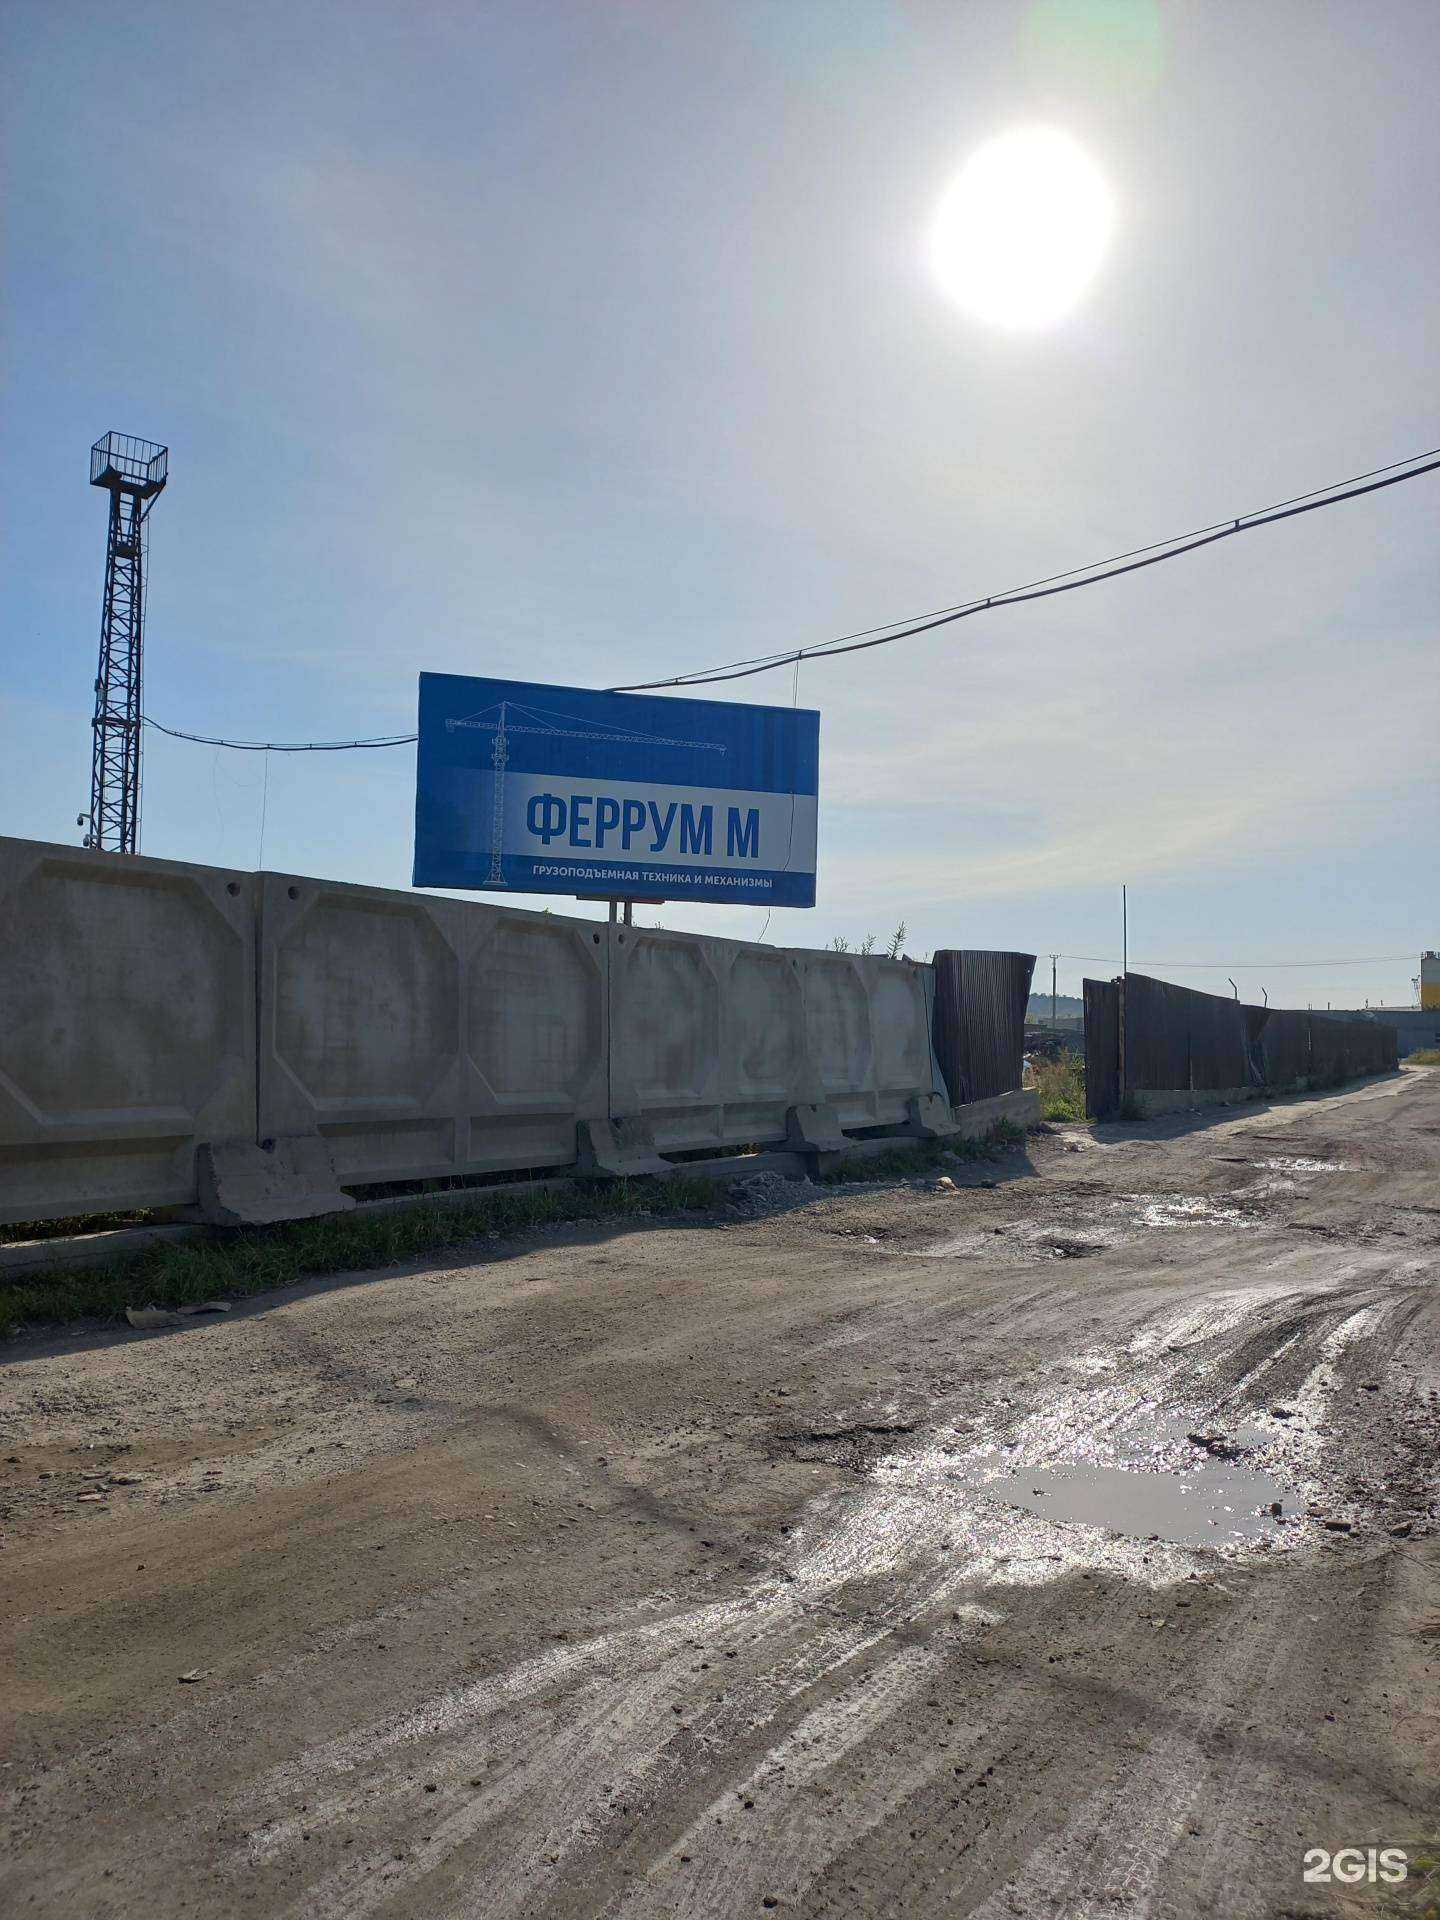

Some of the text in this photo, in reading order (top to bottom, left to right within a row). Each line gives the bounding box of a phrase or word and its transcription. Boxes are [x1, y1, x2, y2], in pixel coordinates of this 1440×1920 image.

[526, 793, 760, 859] ФЕРРУМ М
[532, 865, 773, 888] ГРУЗОПОДЪЕМНАЯ ТЕХНИКА И МЕХАНИЗМЫ
